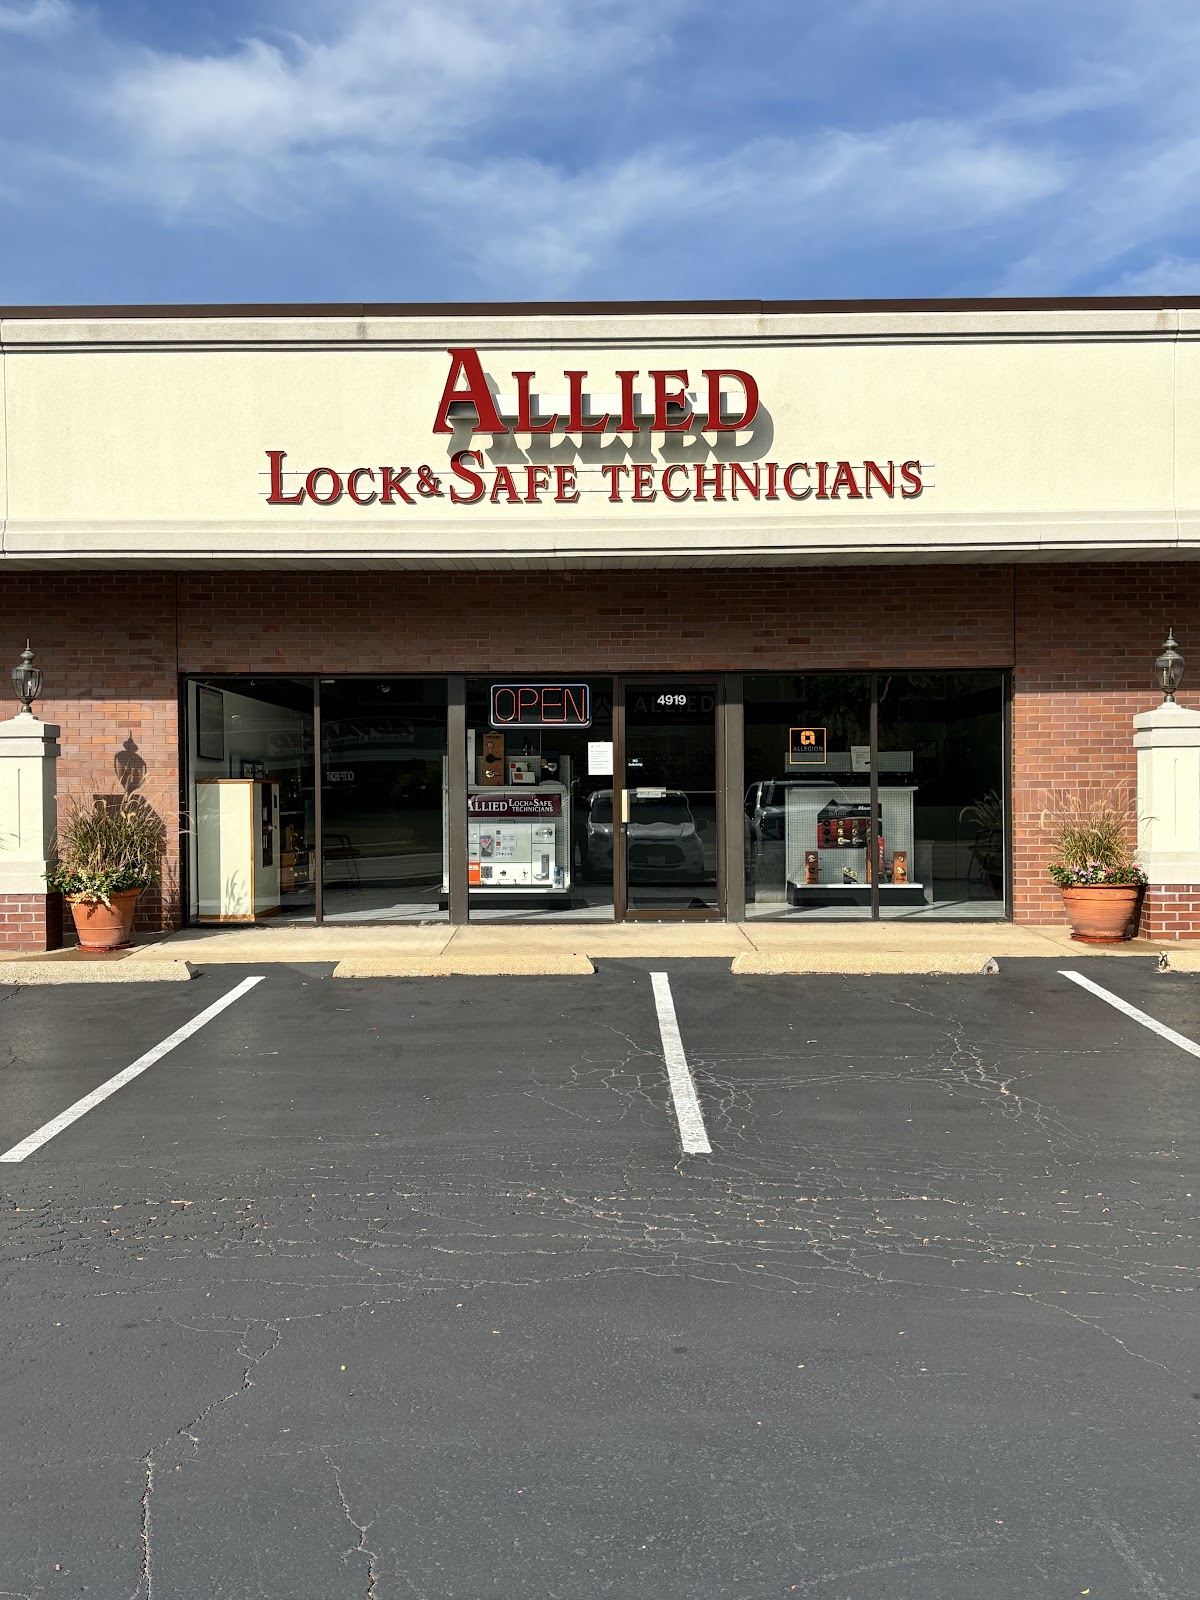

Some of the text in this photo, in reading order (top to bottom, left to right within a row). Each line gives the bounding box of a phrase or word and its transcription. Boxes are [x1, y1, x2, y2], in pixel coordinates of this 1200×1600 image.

[433, 348, 759, 433] ALLIED
[603, 461, 923, 500] TECHNICIANS
[494, 687, 586, 723] OPEN
[656, 694, 687, 706] 4919
